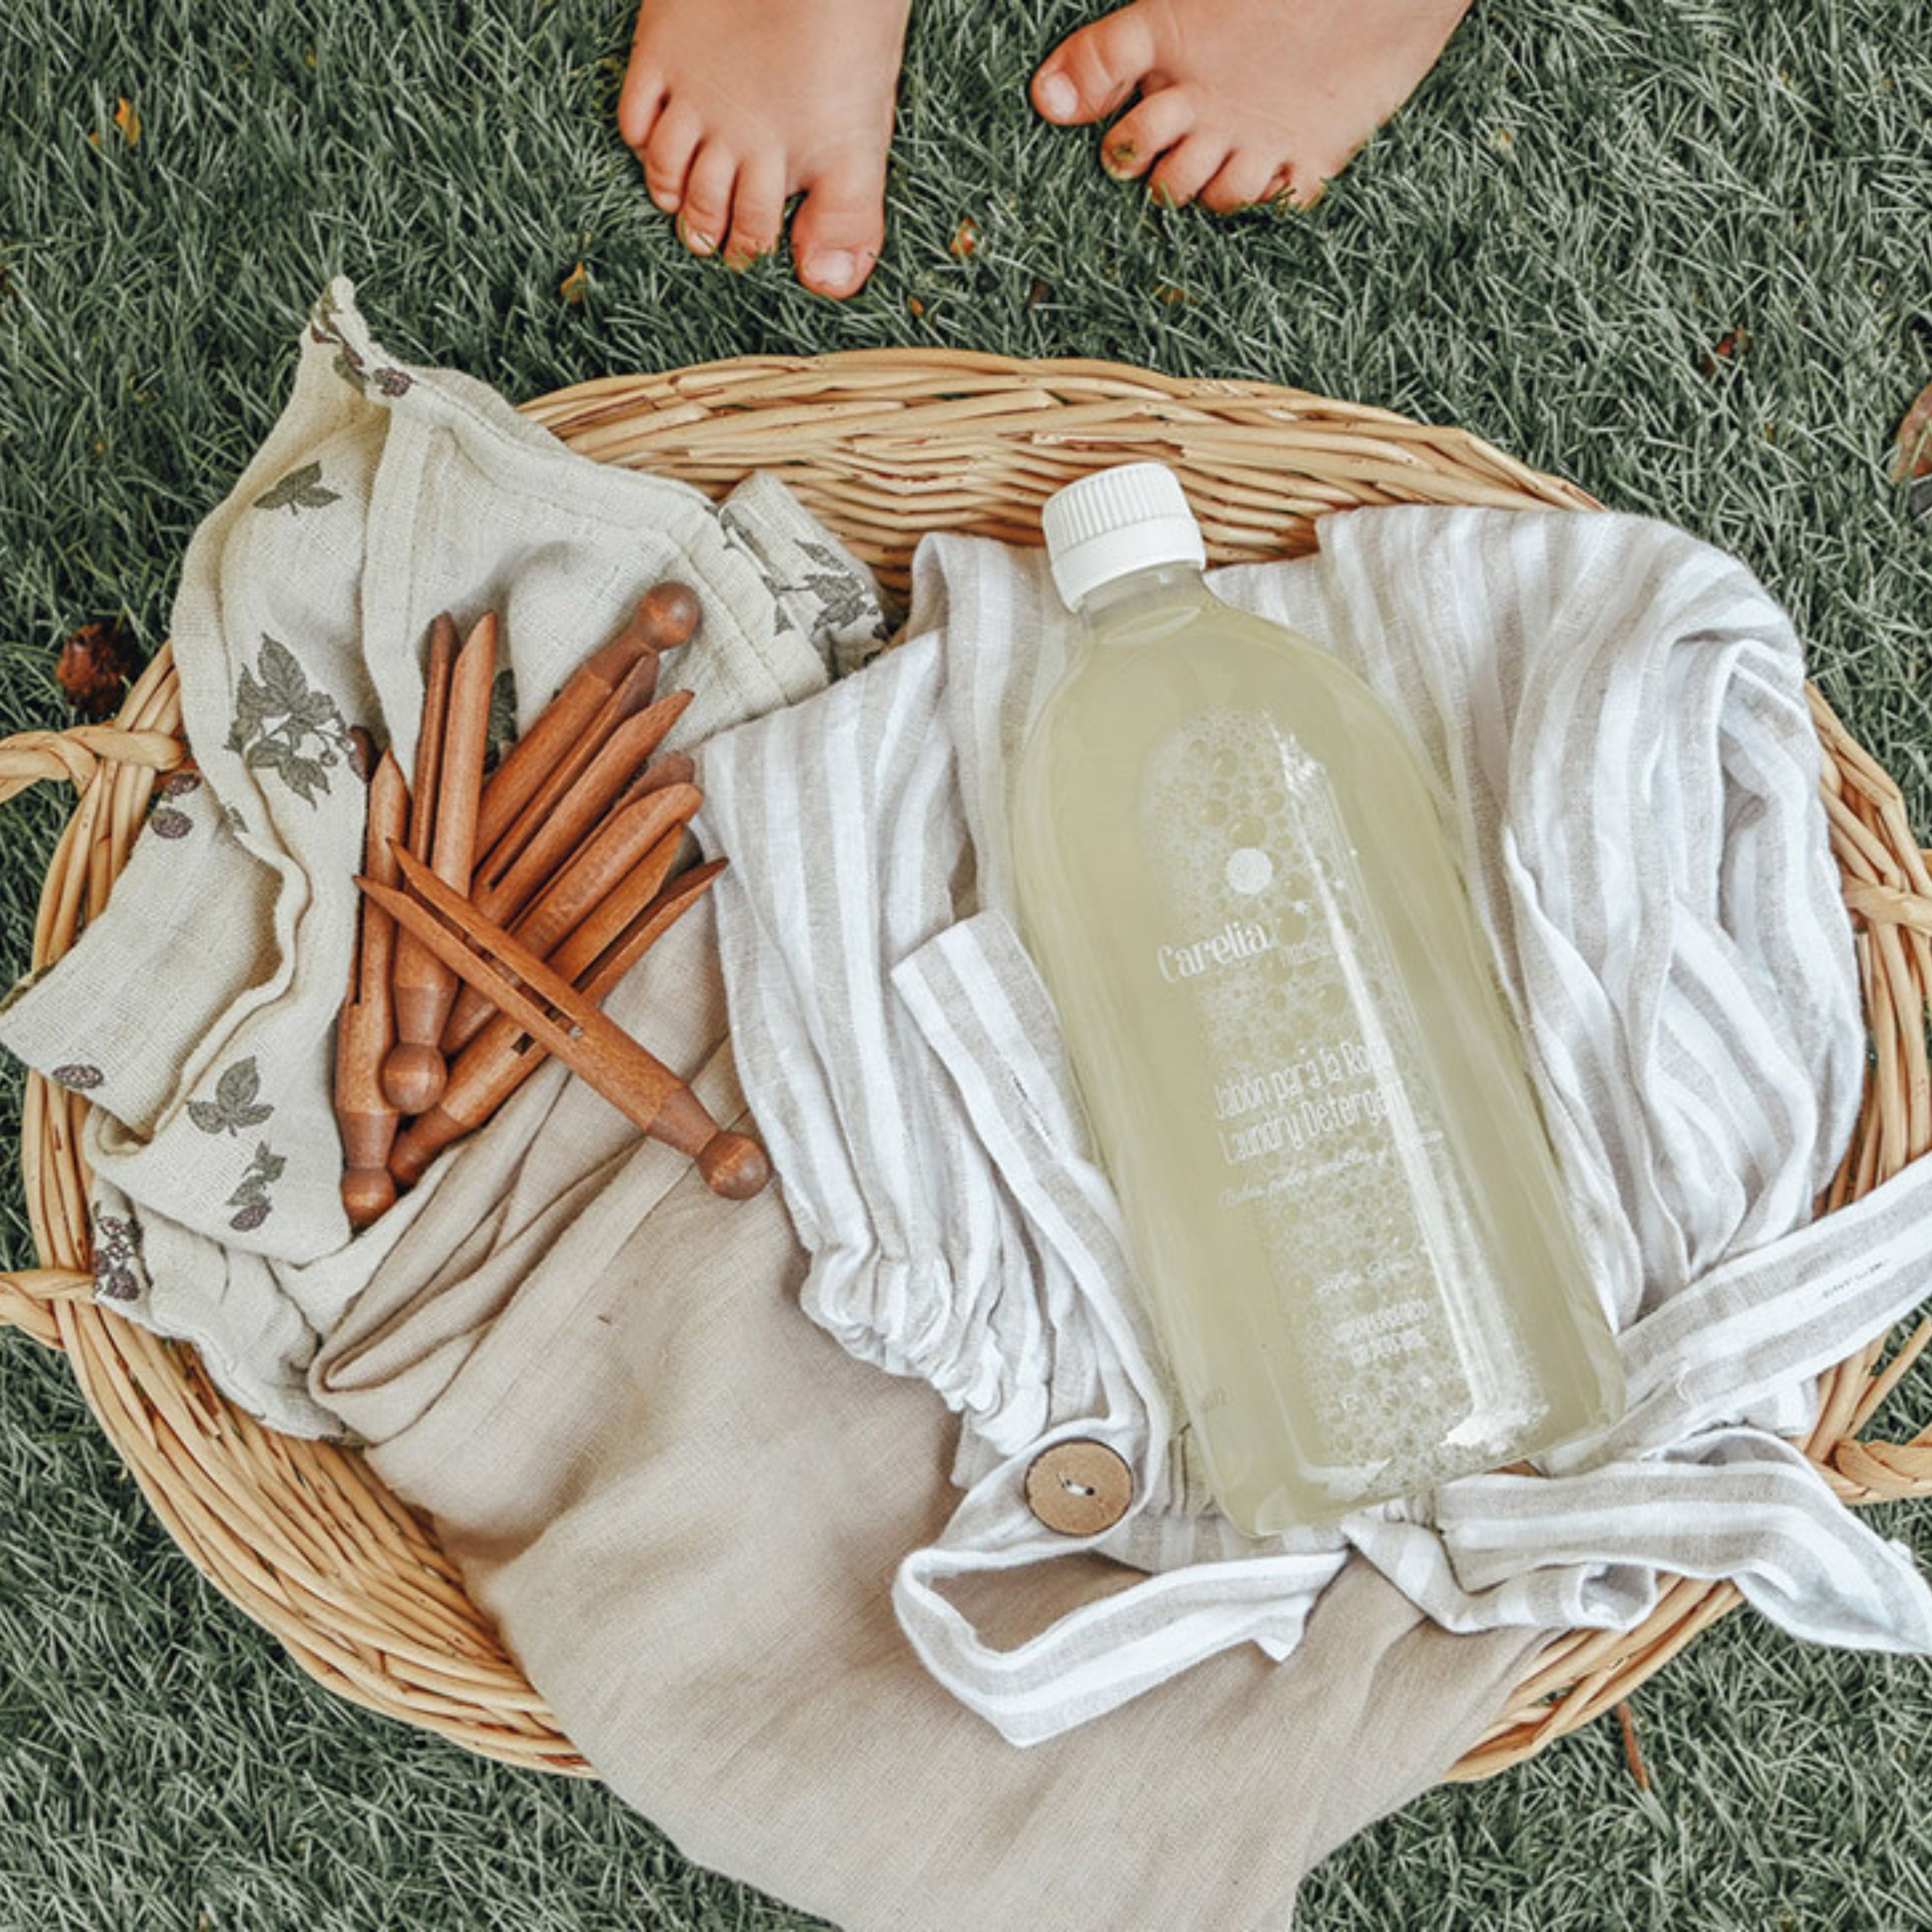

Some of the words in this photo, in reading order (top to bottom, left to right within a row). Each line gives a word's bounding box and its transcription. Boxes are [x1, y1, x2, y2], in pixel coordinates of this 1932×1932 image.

[1157, 921, 1270, 982] Carelia
[1270, 1061, 1321, 1107] para
[1319, 1049, 1342, 1081] la
[1218, 1115, 1304, 1165] Laundry
